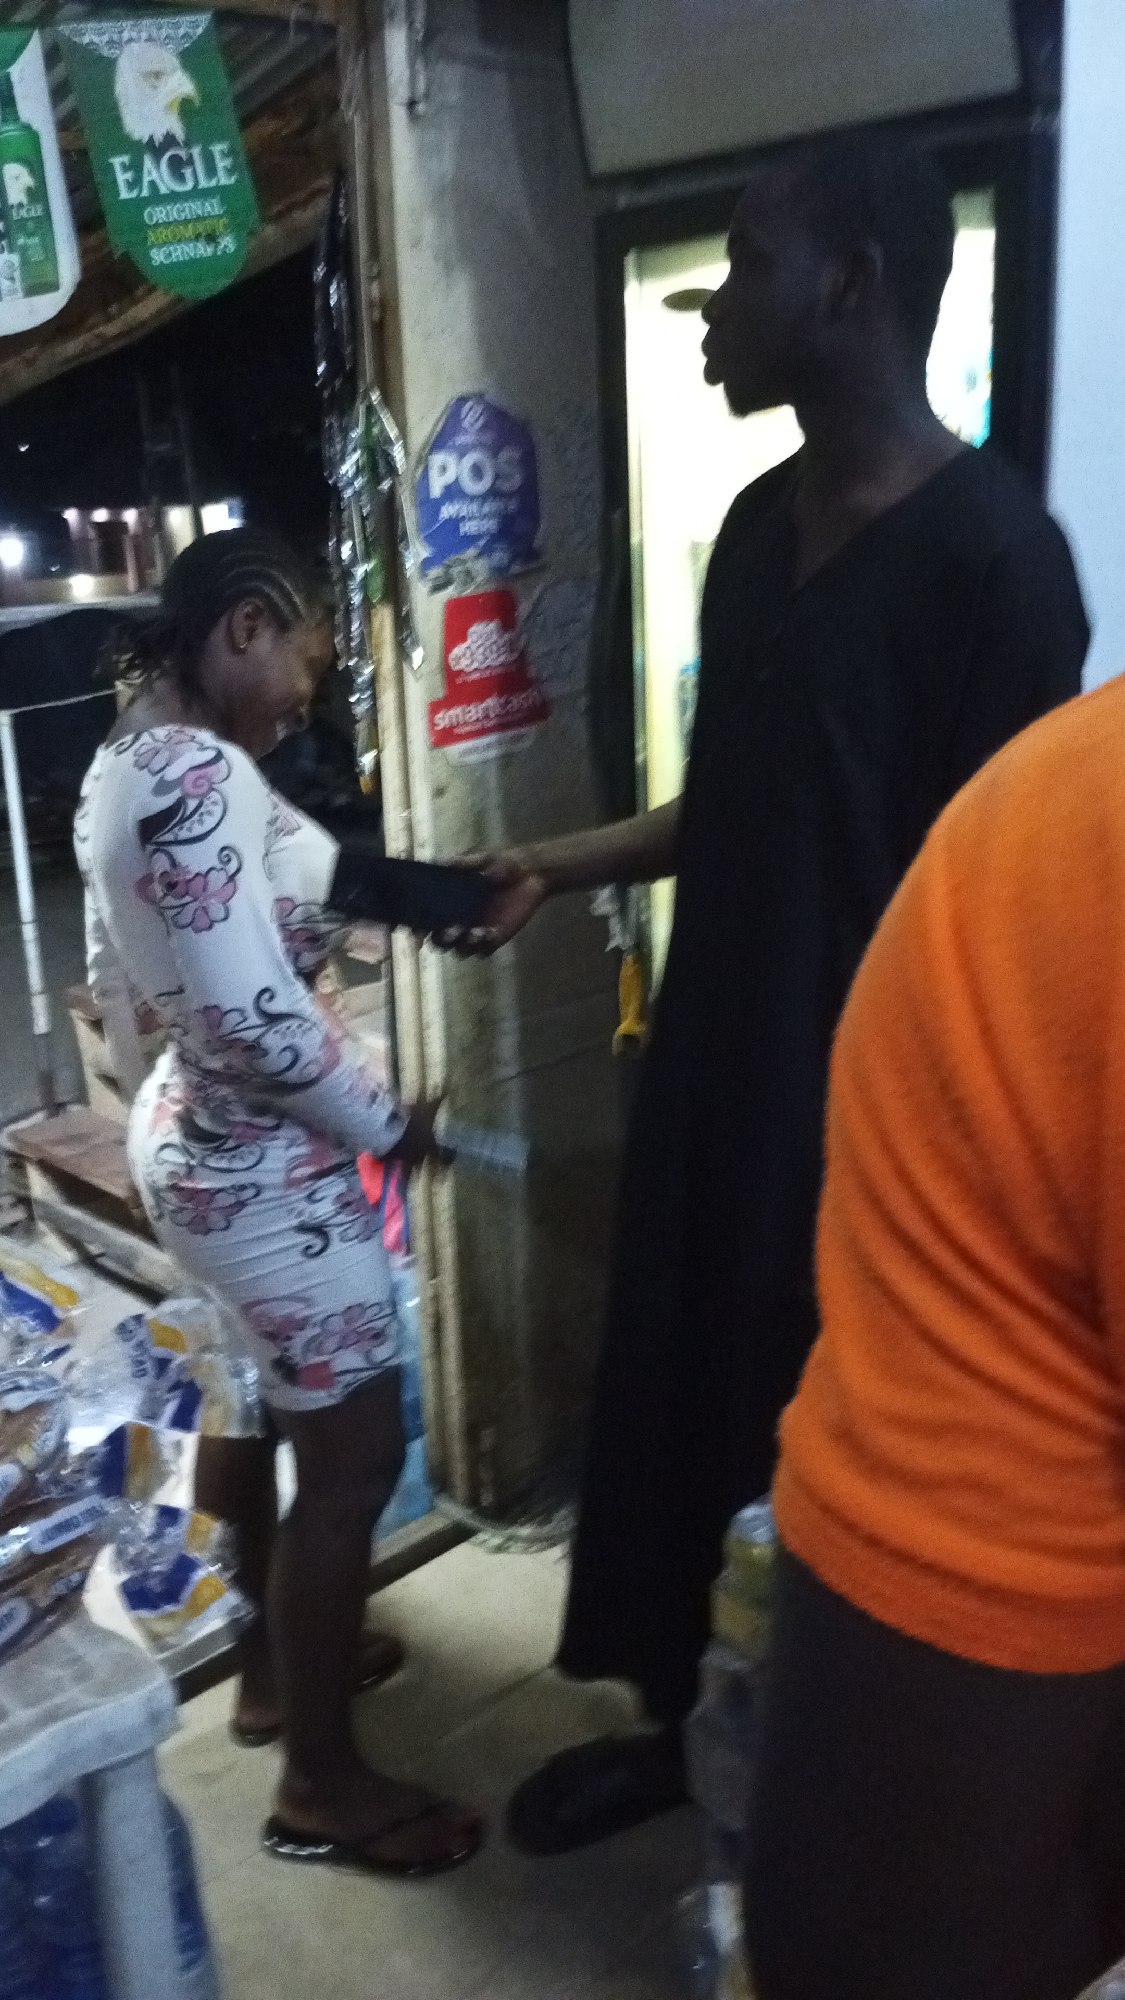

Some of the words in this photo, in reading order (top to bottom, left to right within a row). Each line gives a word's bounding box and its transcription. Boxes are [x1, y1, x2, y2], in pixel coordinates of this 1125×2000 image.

[109, 143, 238, 200] EAGLE
[144, 197, 227, 225] ORIGINAL
[428, 447, 522, 499] POS
